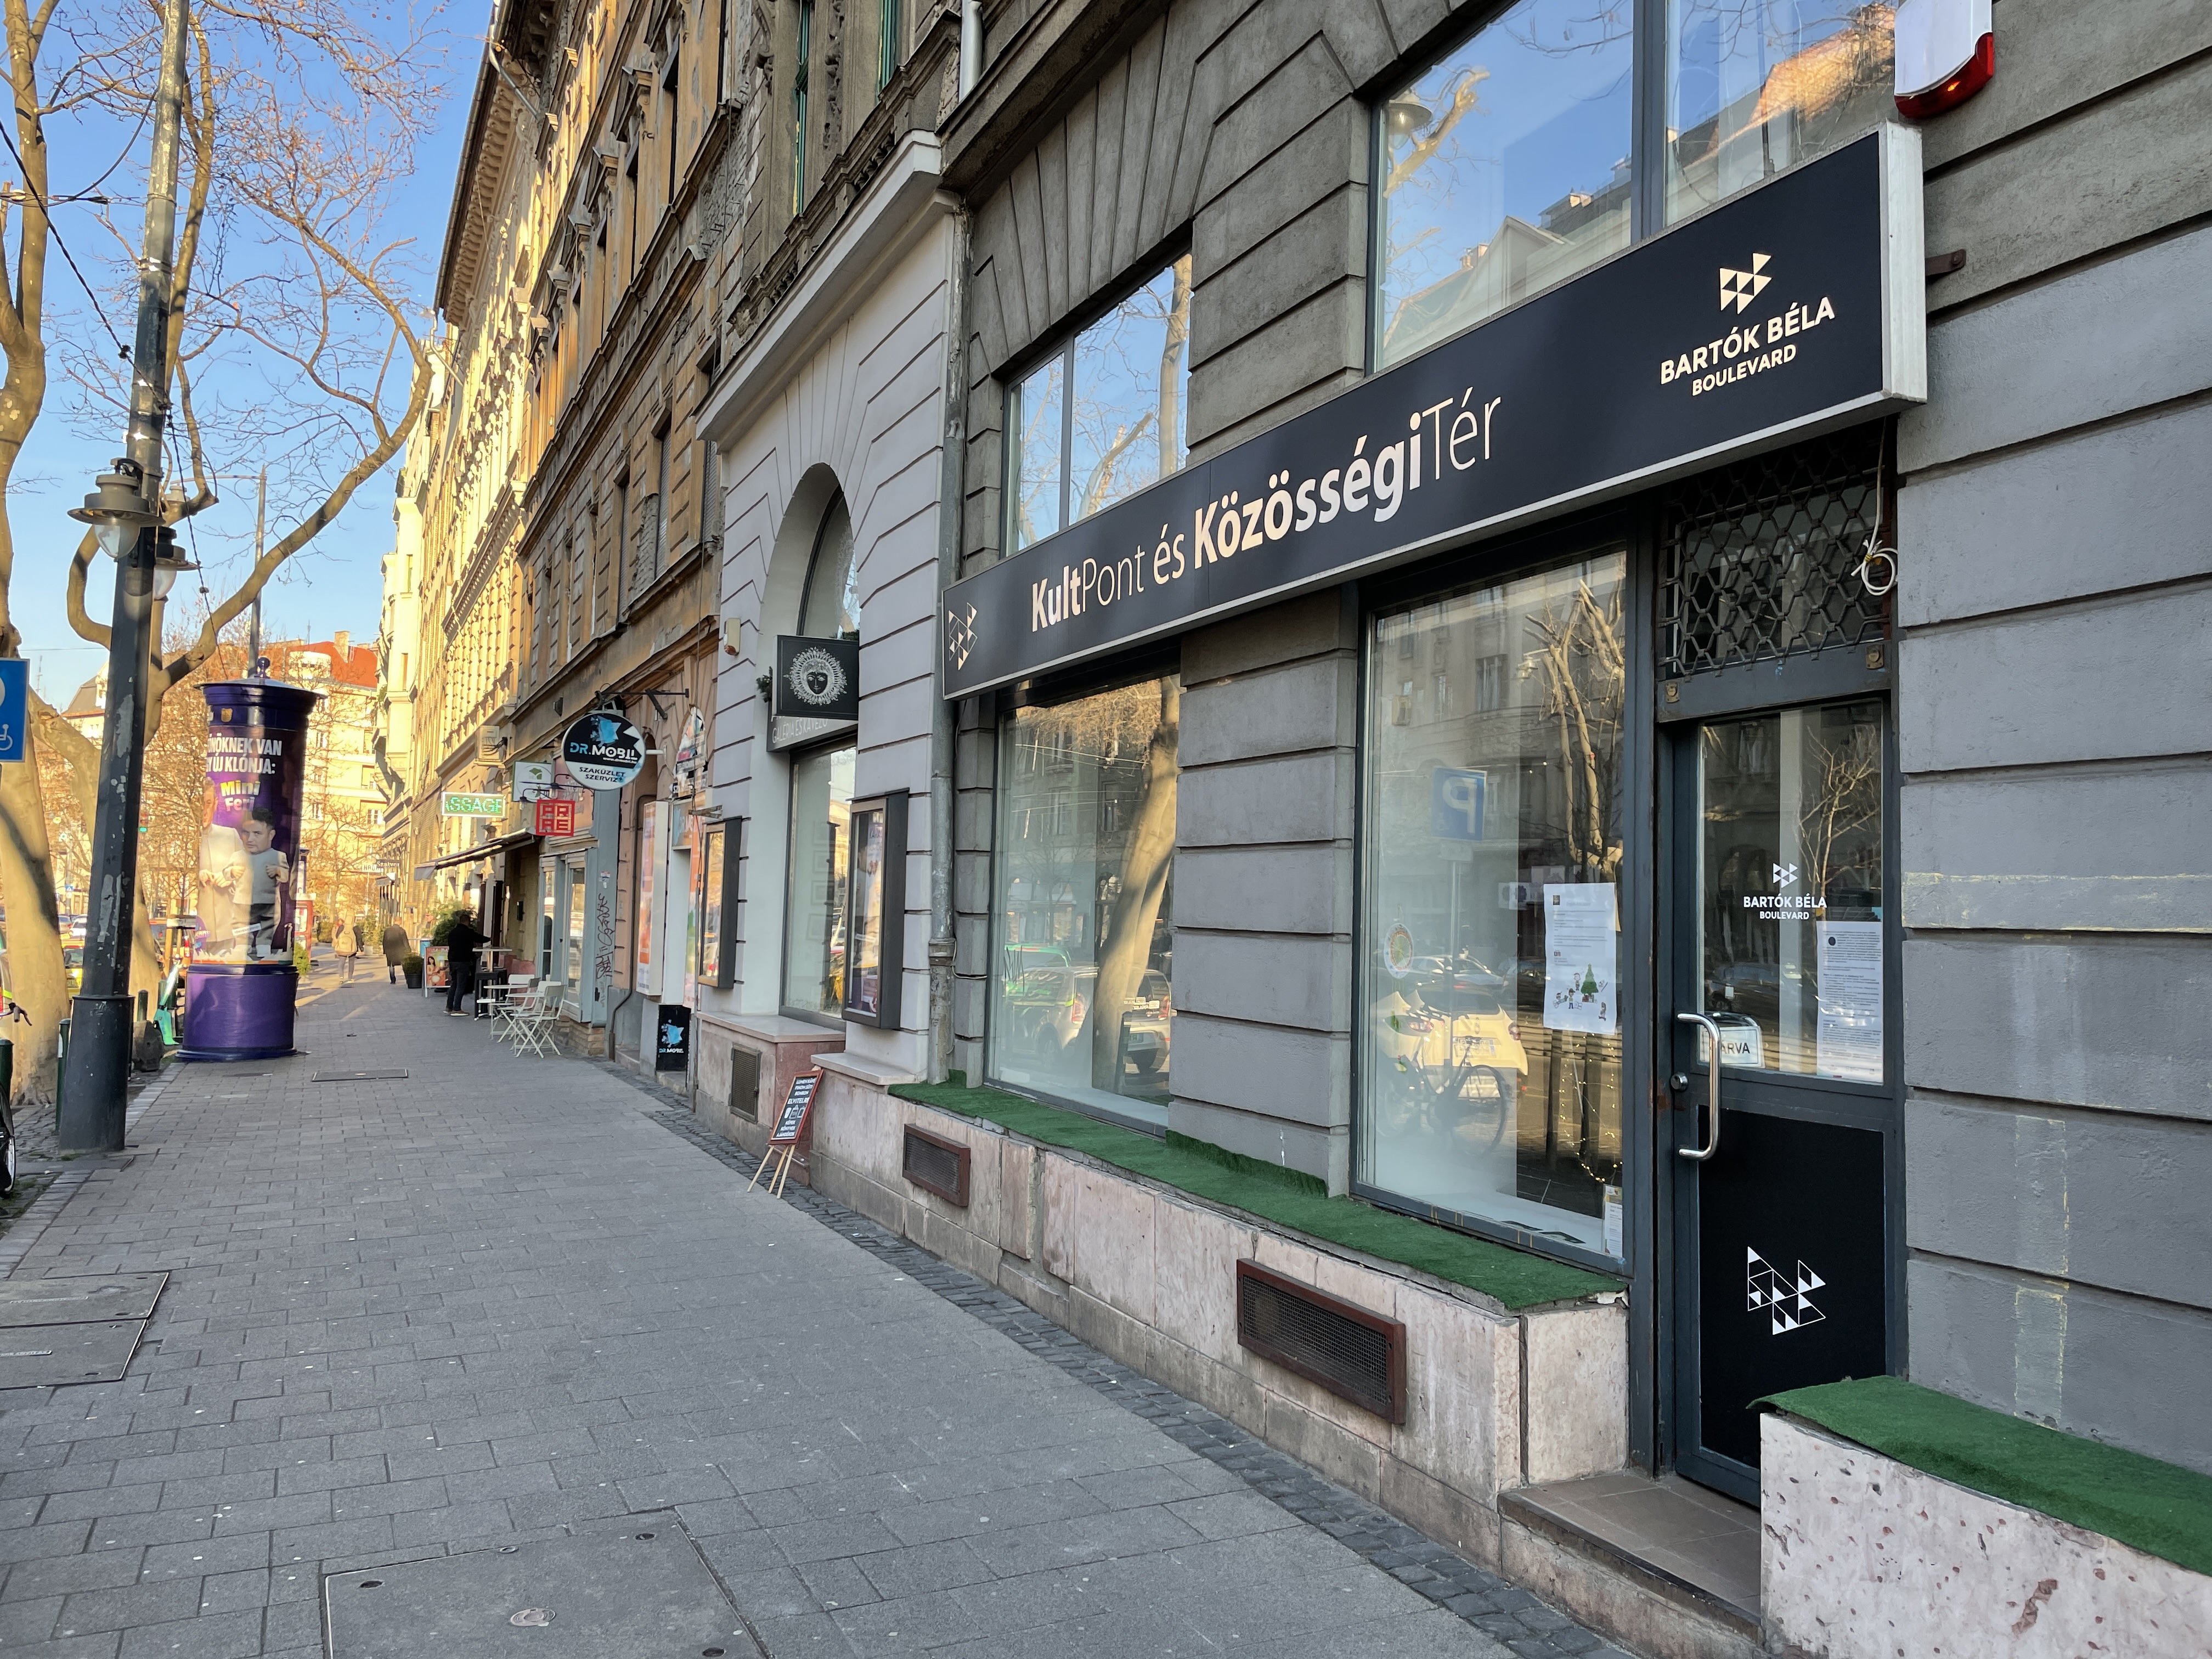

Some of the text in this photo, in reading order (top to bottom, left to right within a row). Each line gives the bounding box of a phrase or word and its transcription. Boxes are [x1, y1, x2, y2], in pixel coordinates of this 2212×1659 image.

[1661, 296, 1835, 385] BARTÓK BÉLA
[1692, 344, 1797, 396] BOULEVARD
[1032, 545, 1146, 632] KultPont
[1153, 523, 1185, 585] és
[257, 739, 282, 756] VAN
[569, 742, 637, 760] DR.MOBIL
[221, 780, 261, 797] Mini
[1743, 893, 1827, 908] BARTÓK BÉLA
[1759, 911, 1809, 920] BOULEVARD
[1720, 1041, 1750, 1054] ÁRVA
